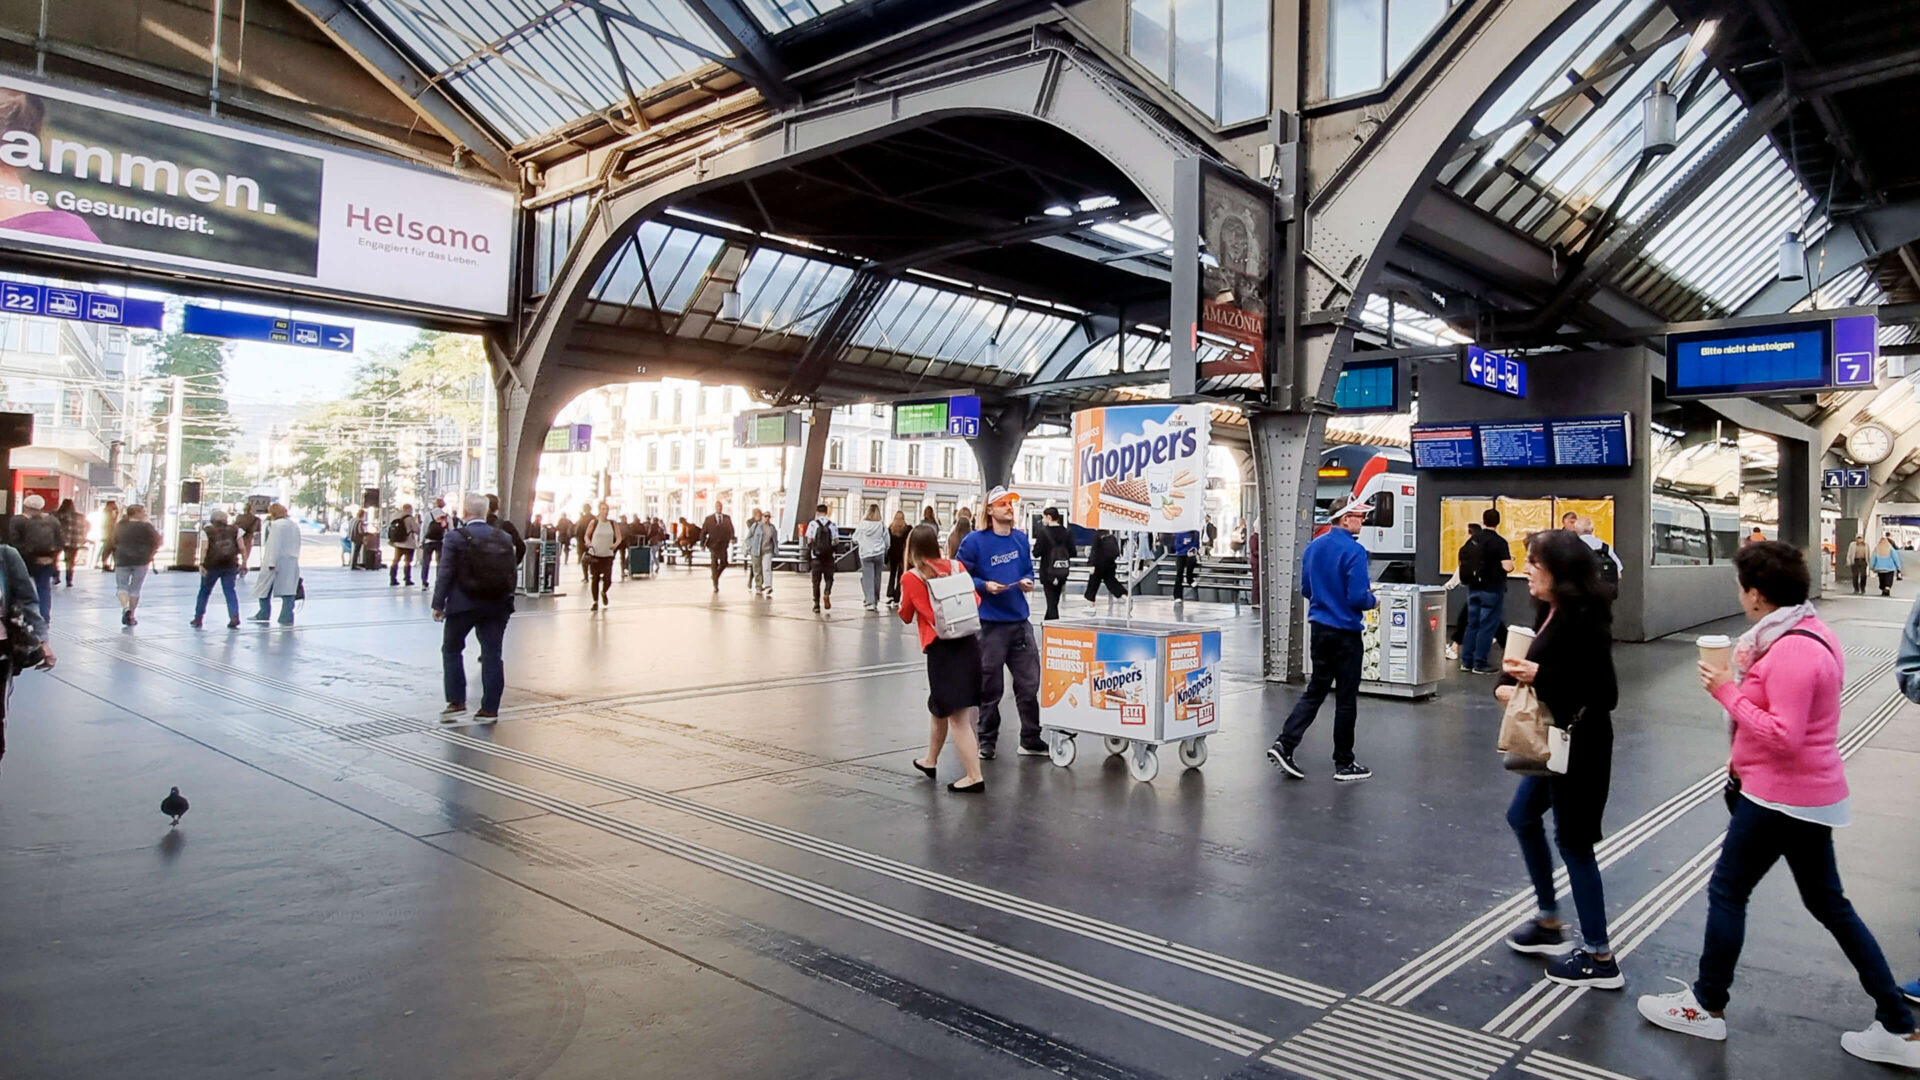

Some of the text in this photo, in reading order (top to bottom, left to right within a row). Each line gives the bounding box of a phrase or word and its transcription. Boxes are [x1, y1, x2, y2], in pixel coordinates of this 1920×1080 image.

[0, 130, 276, 214] ammen.
[55, 190, 214, 235] Gesundheit.
[347, 203, 491, 254] Helsana
[358, 237, 480, 267] Engagiert für das Leben.
[6, 293, 34, 310] 22
[1701, 341, 1795, 356] Bitte nicht einsteigen
[1486, 365, 1518, 390] 21 34
[1847, 364, 1860, 380] 7
[953, 423, 975, 434] 5 5
[1080, 427, 1197, 487] Knoppers
[1829, 474, 1862, 485] A 7
[1093, 669, 1143, 692] Knoppers
[1177, 672, 1212, 705] Knoppers
